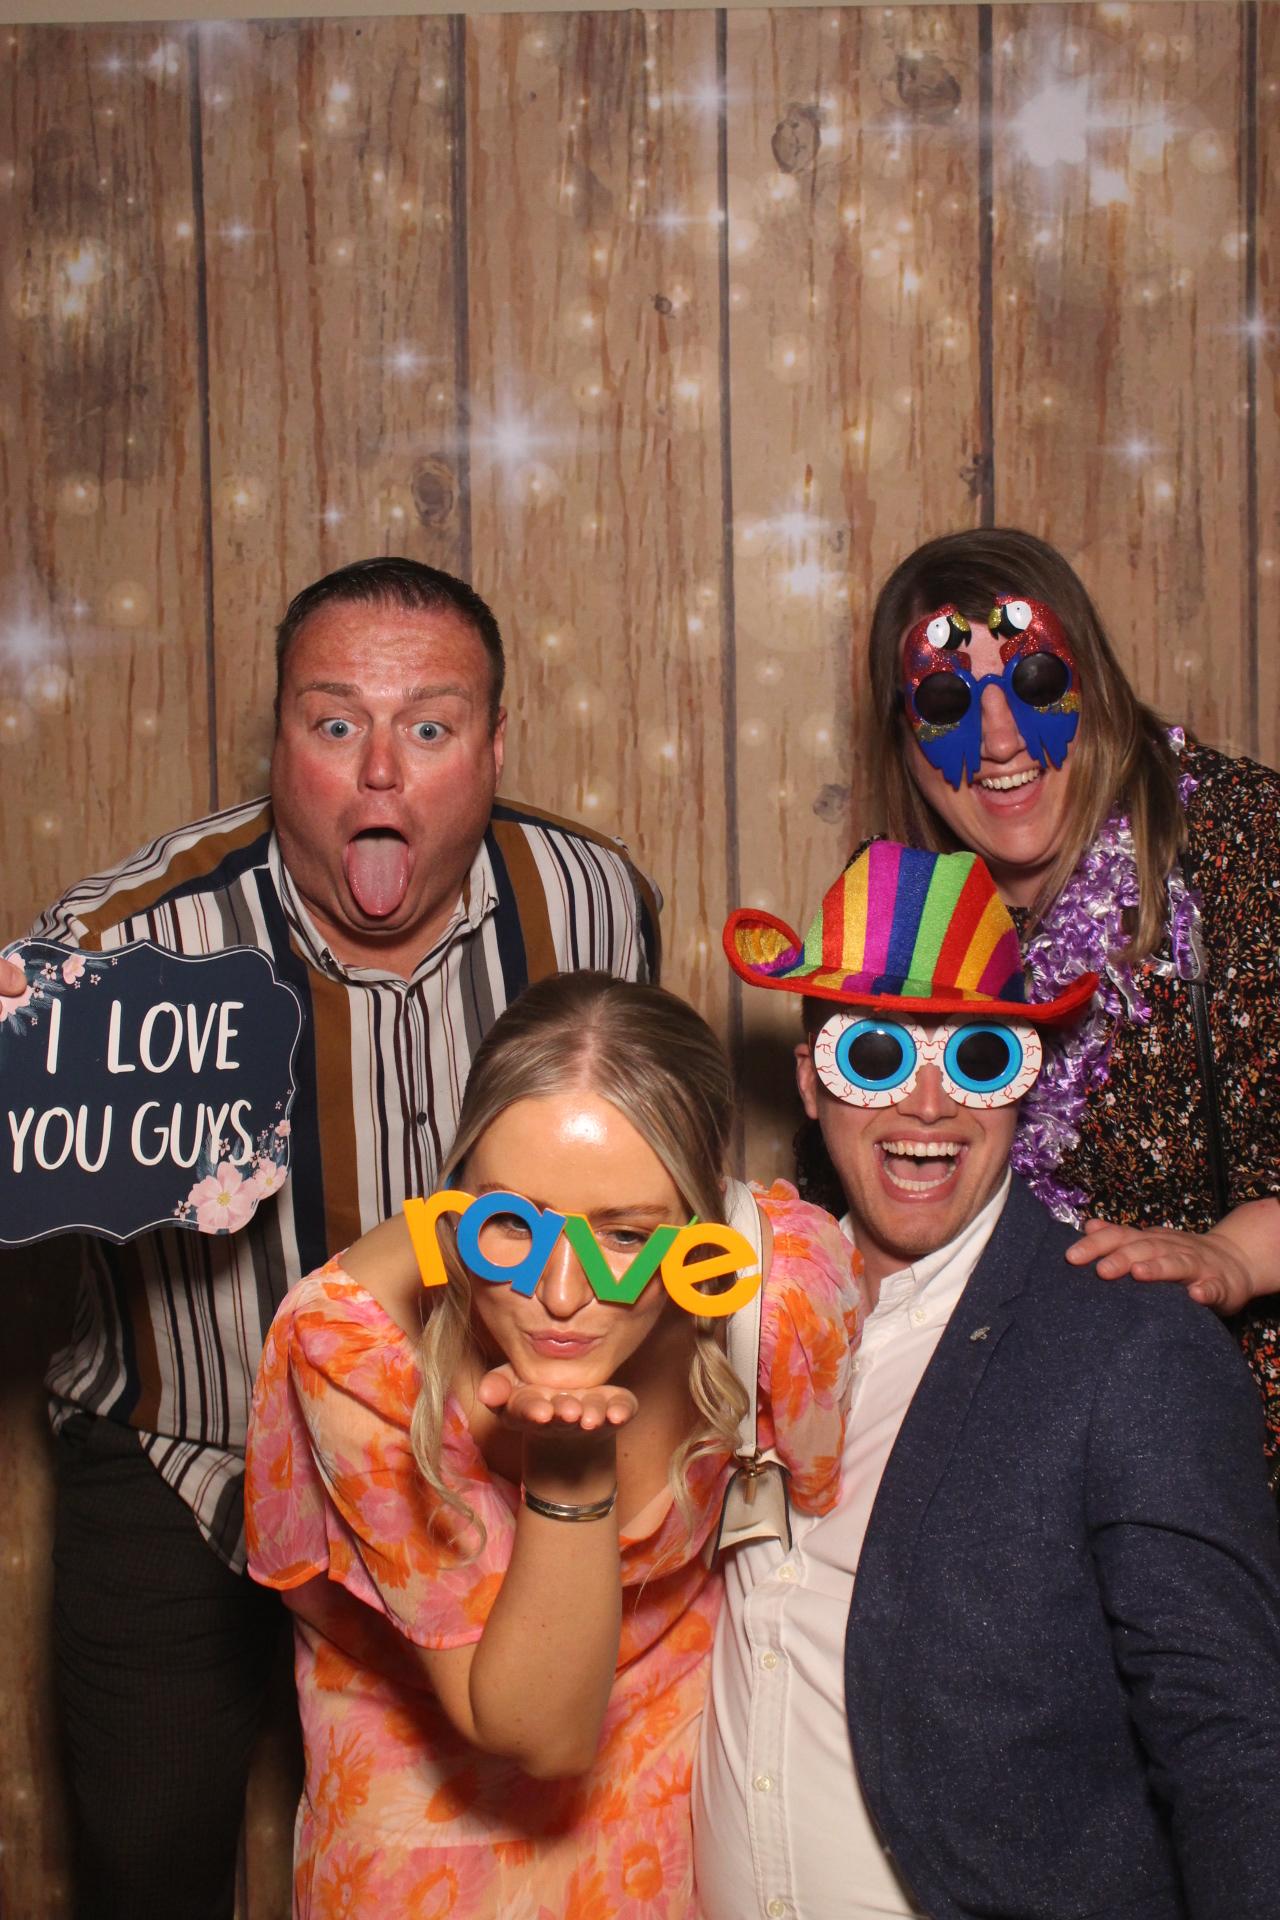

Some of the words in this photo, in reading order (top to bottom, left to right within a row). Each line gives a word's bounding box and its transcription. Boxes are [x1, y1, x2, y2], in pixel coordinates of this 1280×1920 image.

[46, 998, 62, 1074] I
[107, 1000, 244, 1074] LOVE
[8, 1105, 113, 1173] YOU
[131, 1100, 252, 1168] GUYS
[403, 1190, 762, 1317] rave
